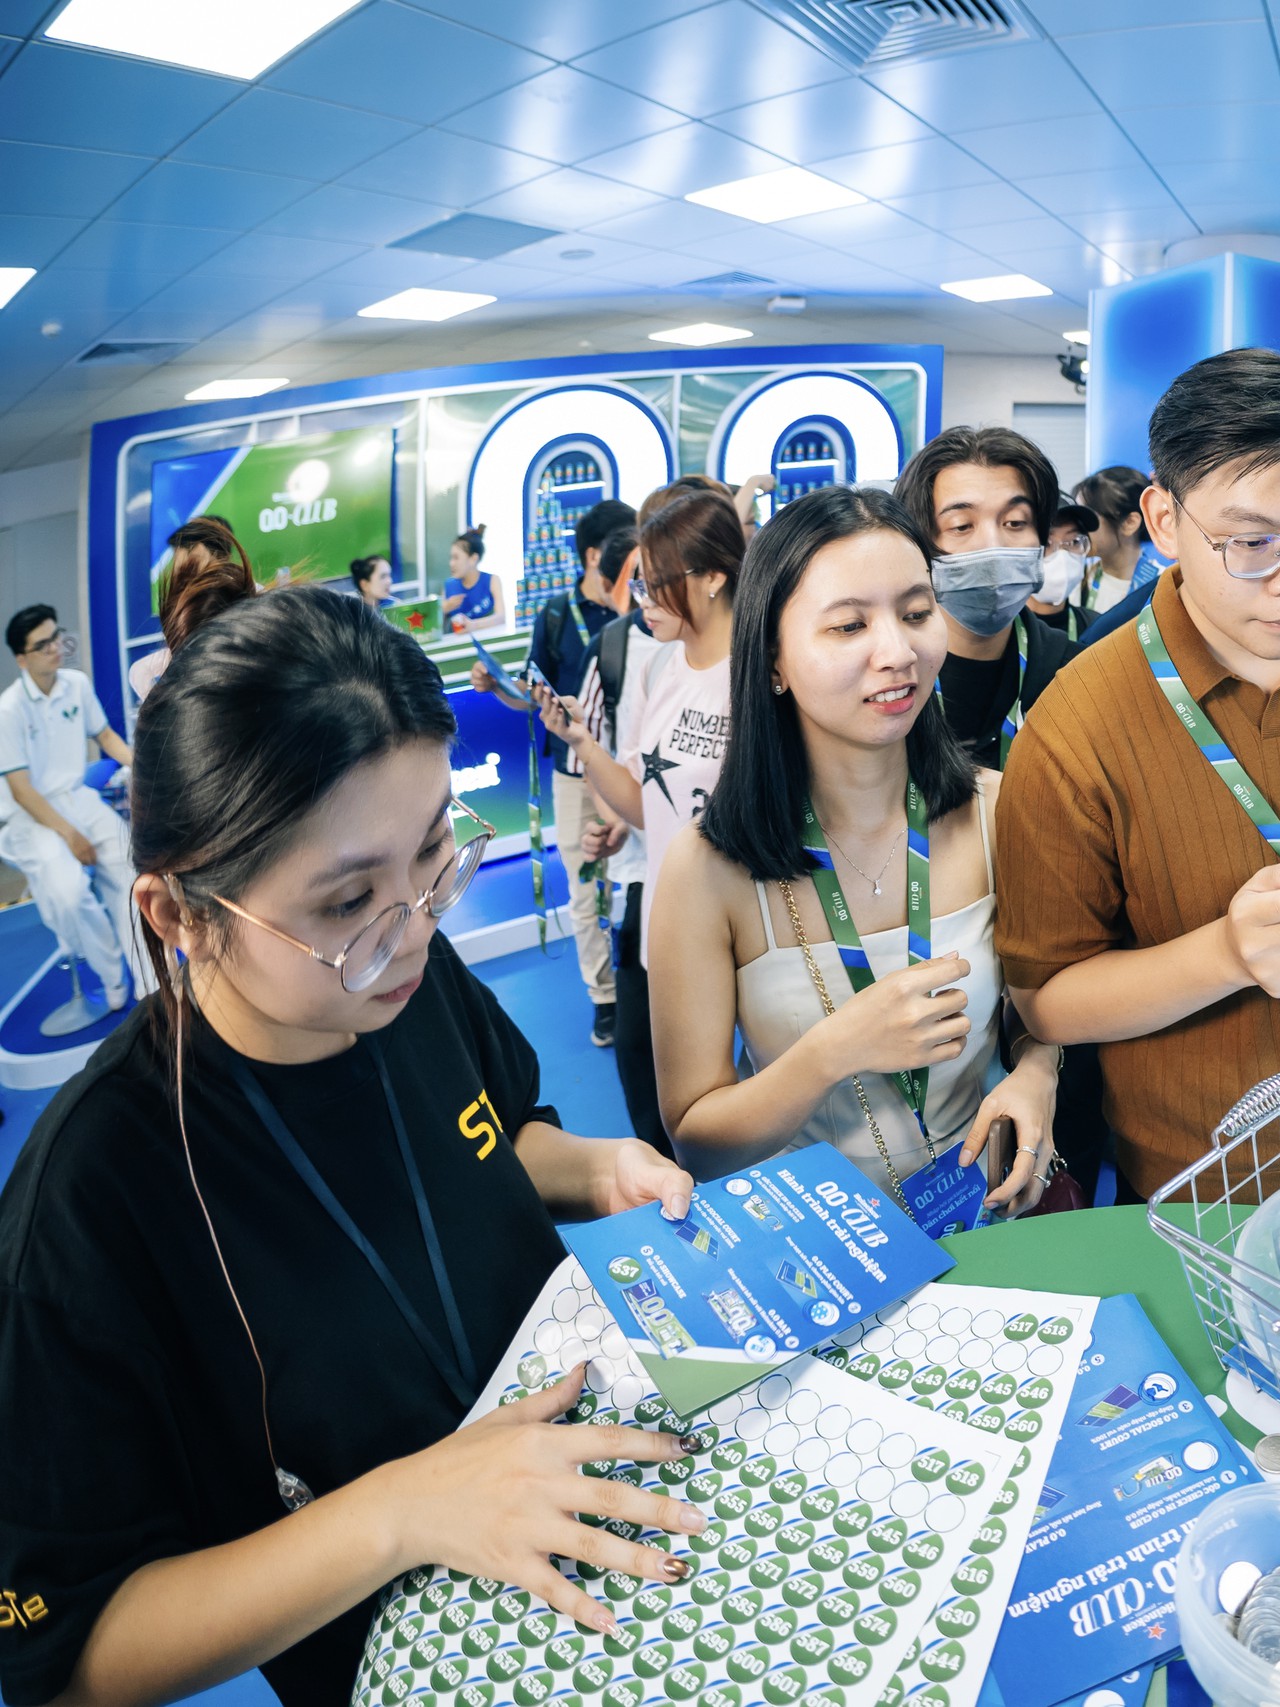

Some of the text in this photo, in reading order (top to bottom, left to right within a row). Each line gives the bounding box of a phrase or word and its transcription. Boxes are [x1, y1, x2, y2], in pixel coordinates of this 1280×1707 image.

[679, 708, 731, 736] NUMBE
[937, 1166, 964, 1193] CLUB
[706, 1207, 725, 1226] SOCIAL
[722, 1224, 741, 1242] COURT
[777, 1169, 804, 1194] Hành
[801, 1193, 829, 1220] trình
[826, 1219, 850, 1242] trải
[845, 1240, 886, 1282] nghiệm
[841, 1206, 888, 1247] CLUB
[921, 1217, 939, 1232] Dân
[938, 1203, 956, 1219] chơi
[954, 1194, 968, 1207] kết
[612, 1263, 639, 1279] 537
[660, 1264, 686, 1298] SHOWCASE
[820, 1265, 836, 1281] PLAY
[833, 1279, 854, 1300] COURT
[776, 1319, 791, 1335] BAR
[1008, 1321, 1068, 1336] 517 518
[850, 1360, 875, 1376] 541
[882, 1366, 908, 1382] 542
[915, 1373, 943, 1387] 543
[948, 1377, 978, 1391] 544
[983, 1382, 1013, 1396] 545
[1019, 1386, 1050, 1400] 546
[972, 1413, 1039, 1433] 559 560
[1100, 1412, 1179, 1450] 0.0 SOCIAL COURT
[520, 1357, 916, 1600] 547 553 554 555 556 557 558 559 560
[640, 1399, 938, 1561] 537 538 540 541 542 543 544 545 546
[917, 1453, 978, 1488] 517 518
[1151, 1508, 1166, 1518] 0.0
[1165, 1502, 1177, 1512] IN
[1175, 1490, 1204, 1507] CHECK
[1130, 1514, 1152, 1529] CLUB
[1022, 1528, 1066, 1553] 0.0 PLAY
[700, 1525, 722, 1546] 69
[724, 1543, 752, 1565] 570
[755, 1561, 783, 1583] 571
[787, 1578, 818, 1600] 572
[823, 1597, 854, 1619] 573
[860, 1616, 892, 1638] 574
[956, 1564, 989, 1584] 616
[1005, 1529, 1184, 1617] trình trải nghiệm
[611, 1521, 868, 1677] 581 584 585 586 587 588
[1070, 1578, 1145, 1636] CLUB
[409, 1568, 549, 1701] 633 634 635 636 637 638
[609, 1571, 802, 1699] 596 597 598 599 600 601
[940, 1608, 976, 1627] 630
[1123, 1602, 1177, 1634] Heineken
[385, 1604, 489, 1706] 647 648 649 650 651
[477, 1574, 638, 1706] 621 622 623 624 625 626
[374, 1656, 409, 1700] 662 663
[638, 1648, 667, 1671] 612
[671, 1669, 701, 1693] 613
[924, 1651, 962, 1672] 644
